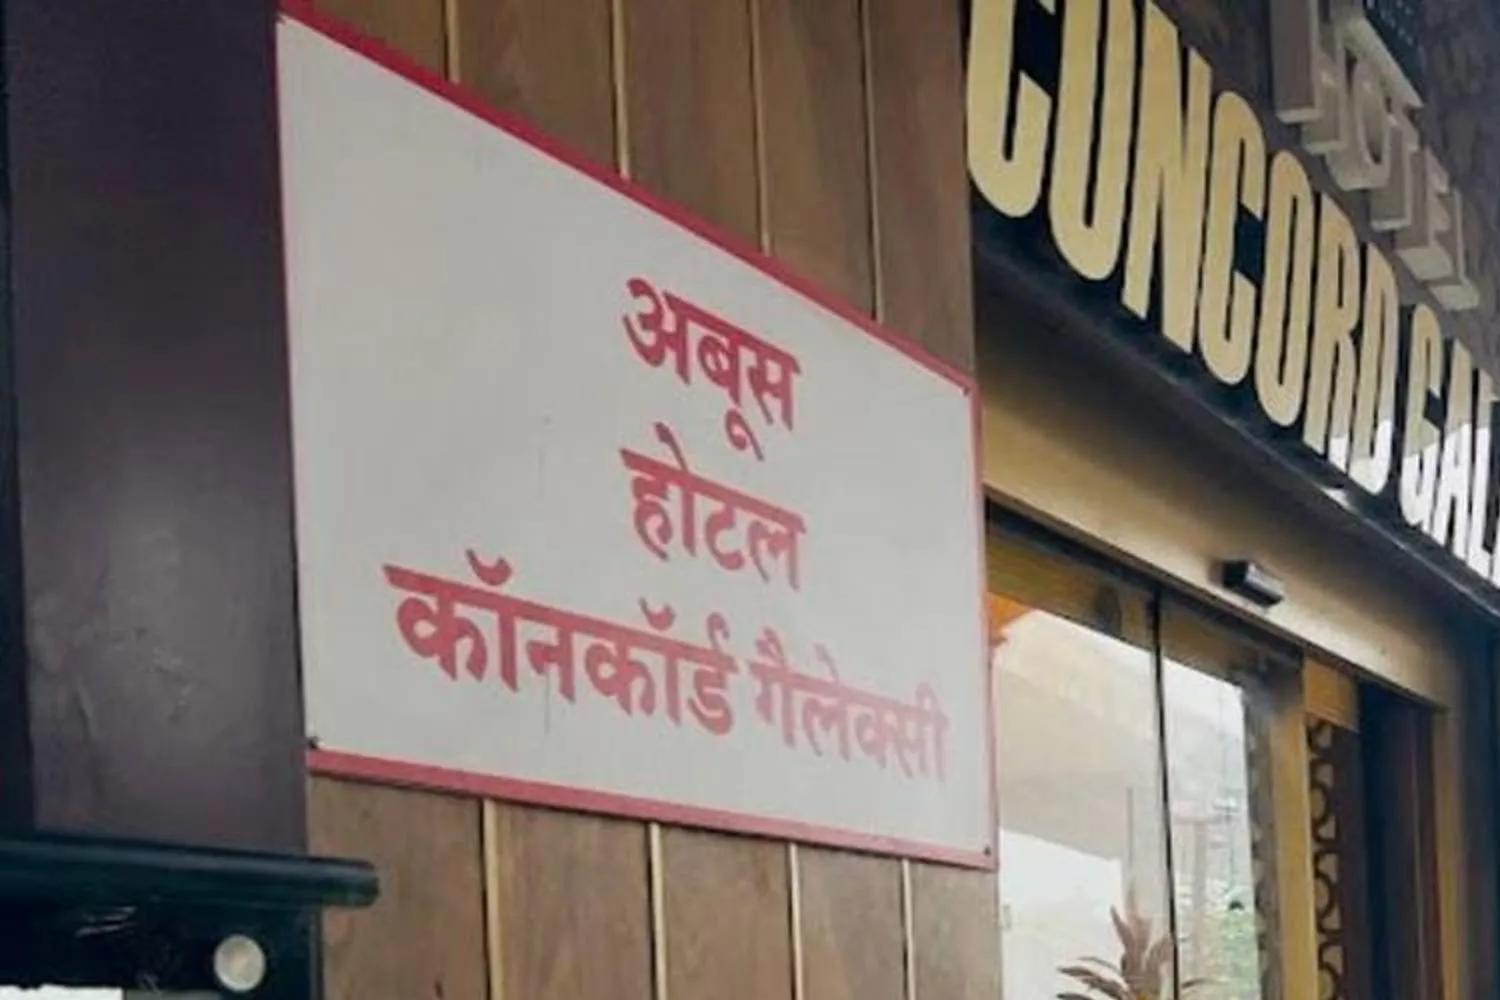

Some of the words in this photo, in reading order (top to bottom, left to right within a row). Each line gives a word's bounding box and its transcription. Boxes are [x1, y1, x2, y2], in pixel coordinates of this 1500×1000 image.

[967, 0, 1400, 496] CONCORD
[622, 277, 802, 460] अबूस
[619, 422, 806, 591] होटल
[382, 549, 739, 736] कॉनकॉर्ड
[747, 627, 948, 782] गैलेक्सी
